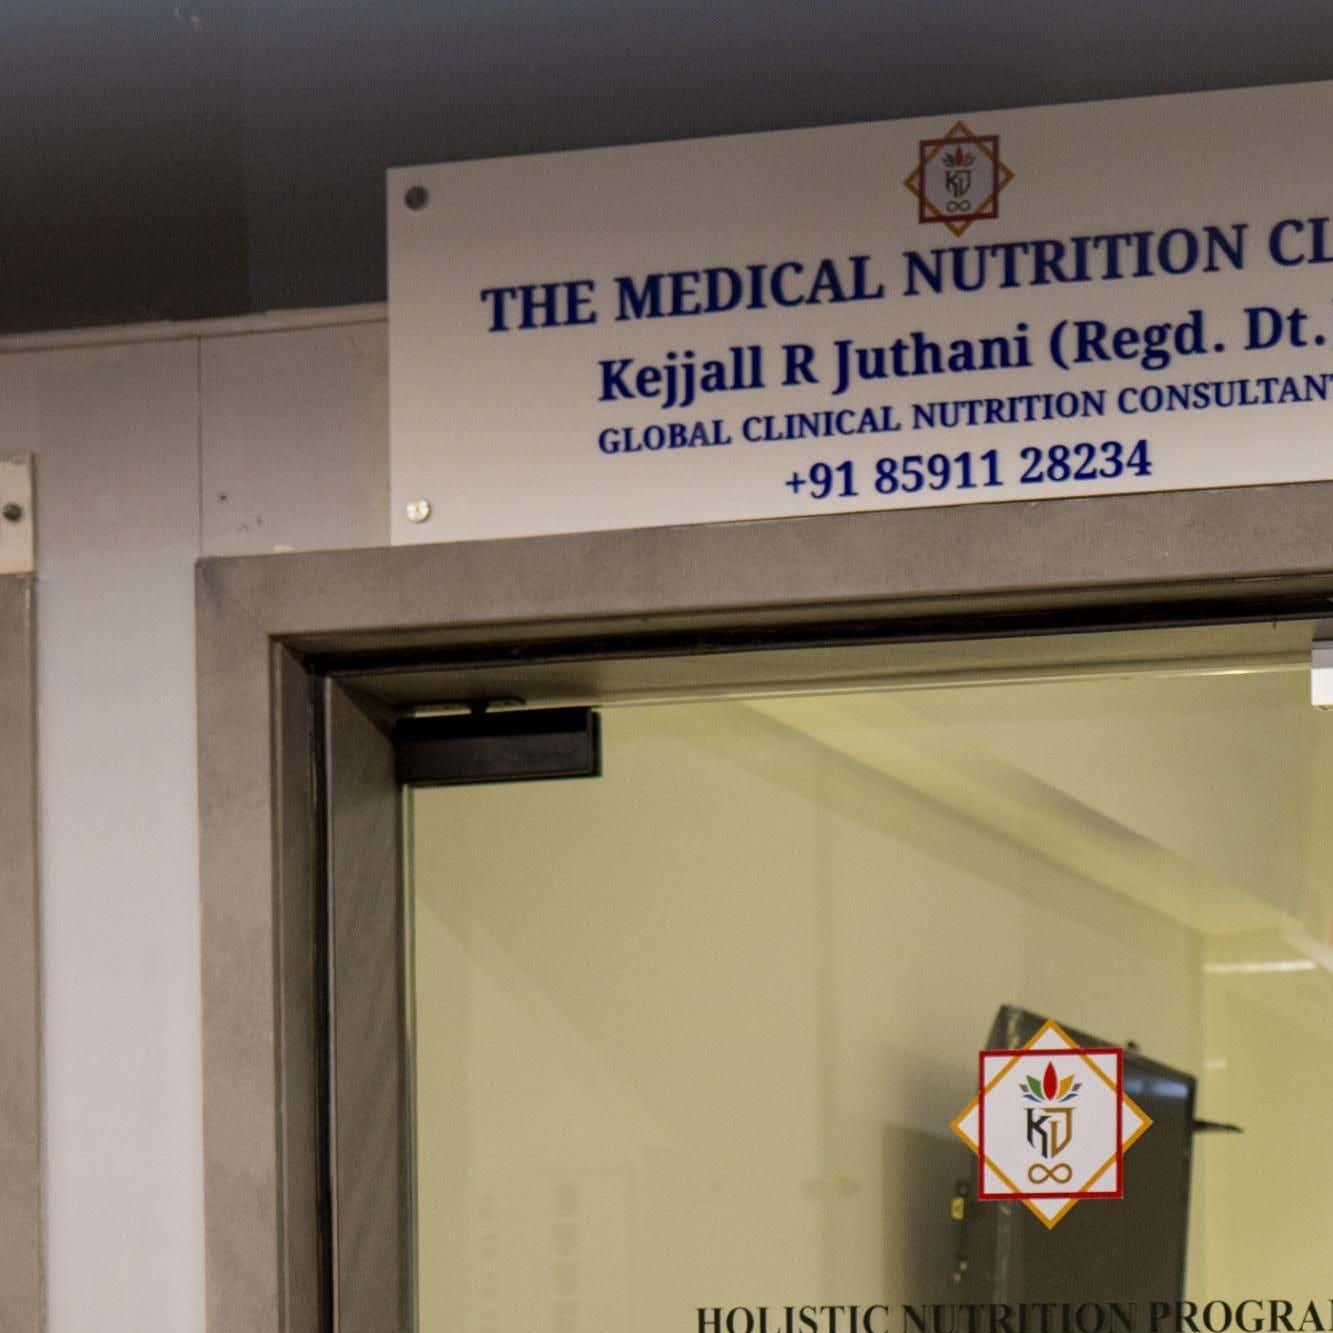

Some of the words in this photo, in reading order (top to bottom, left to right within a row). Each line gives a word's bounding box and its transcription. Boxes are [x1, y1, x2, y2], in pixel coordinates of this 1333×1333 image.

[481, 280, 597, 332] THE
[614, 255, 885, 322] MEDICAL
[903, 224, 1248, 297] NUTRITION
[598, 345, 765, 409] Kejjall
[782, 344, 819, 386] R
[832, 324, 1031, 395] Juthani
[1050, 309, 1225, 371] (Regd.
[598, 419, 732, 454] GLOBAL
[742, 405, 900, 443] CLINICAL
[911, 390, 1107, 430] NUTRITION
[785, 460, 859, 499] +91
[874, 449, 1003, 495] 85911
[1020, 439, 1152, 484] 28234
